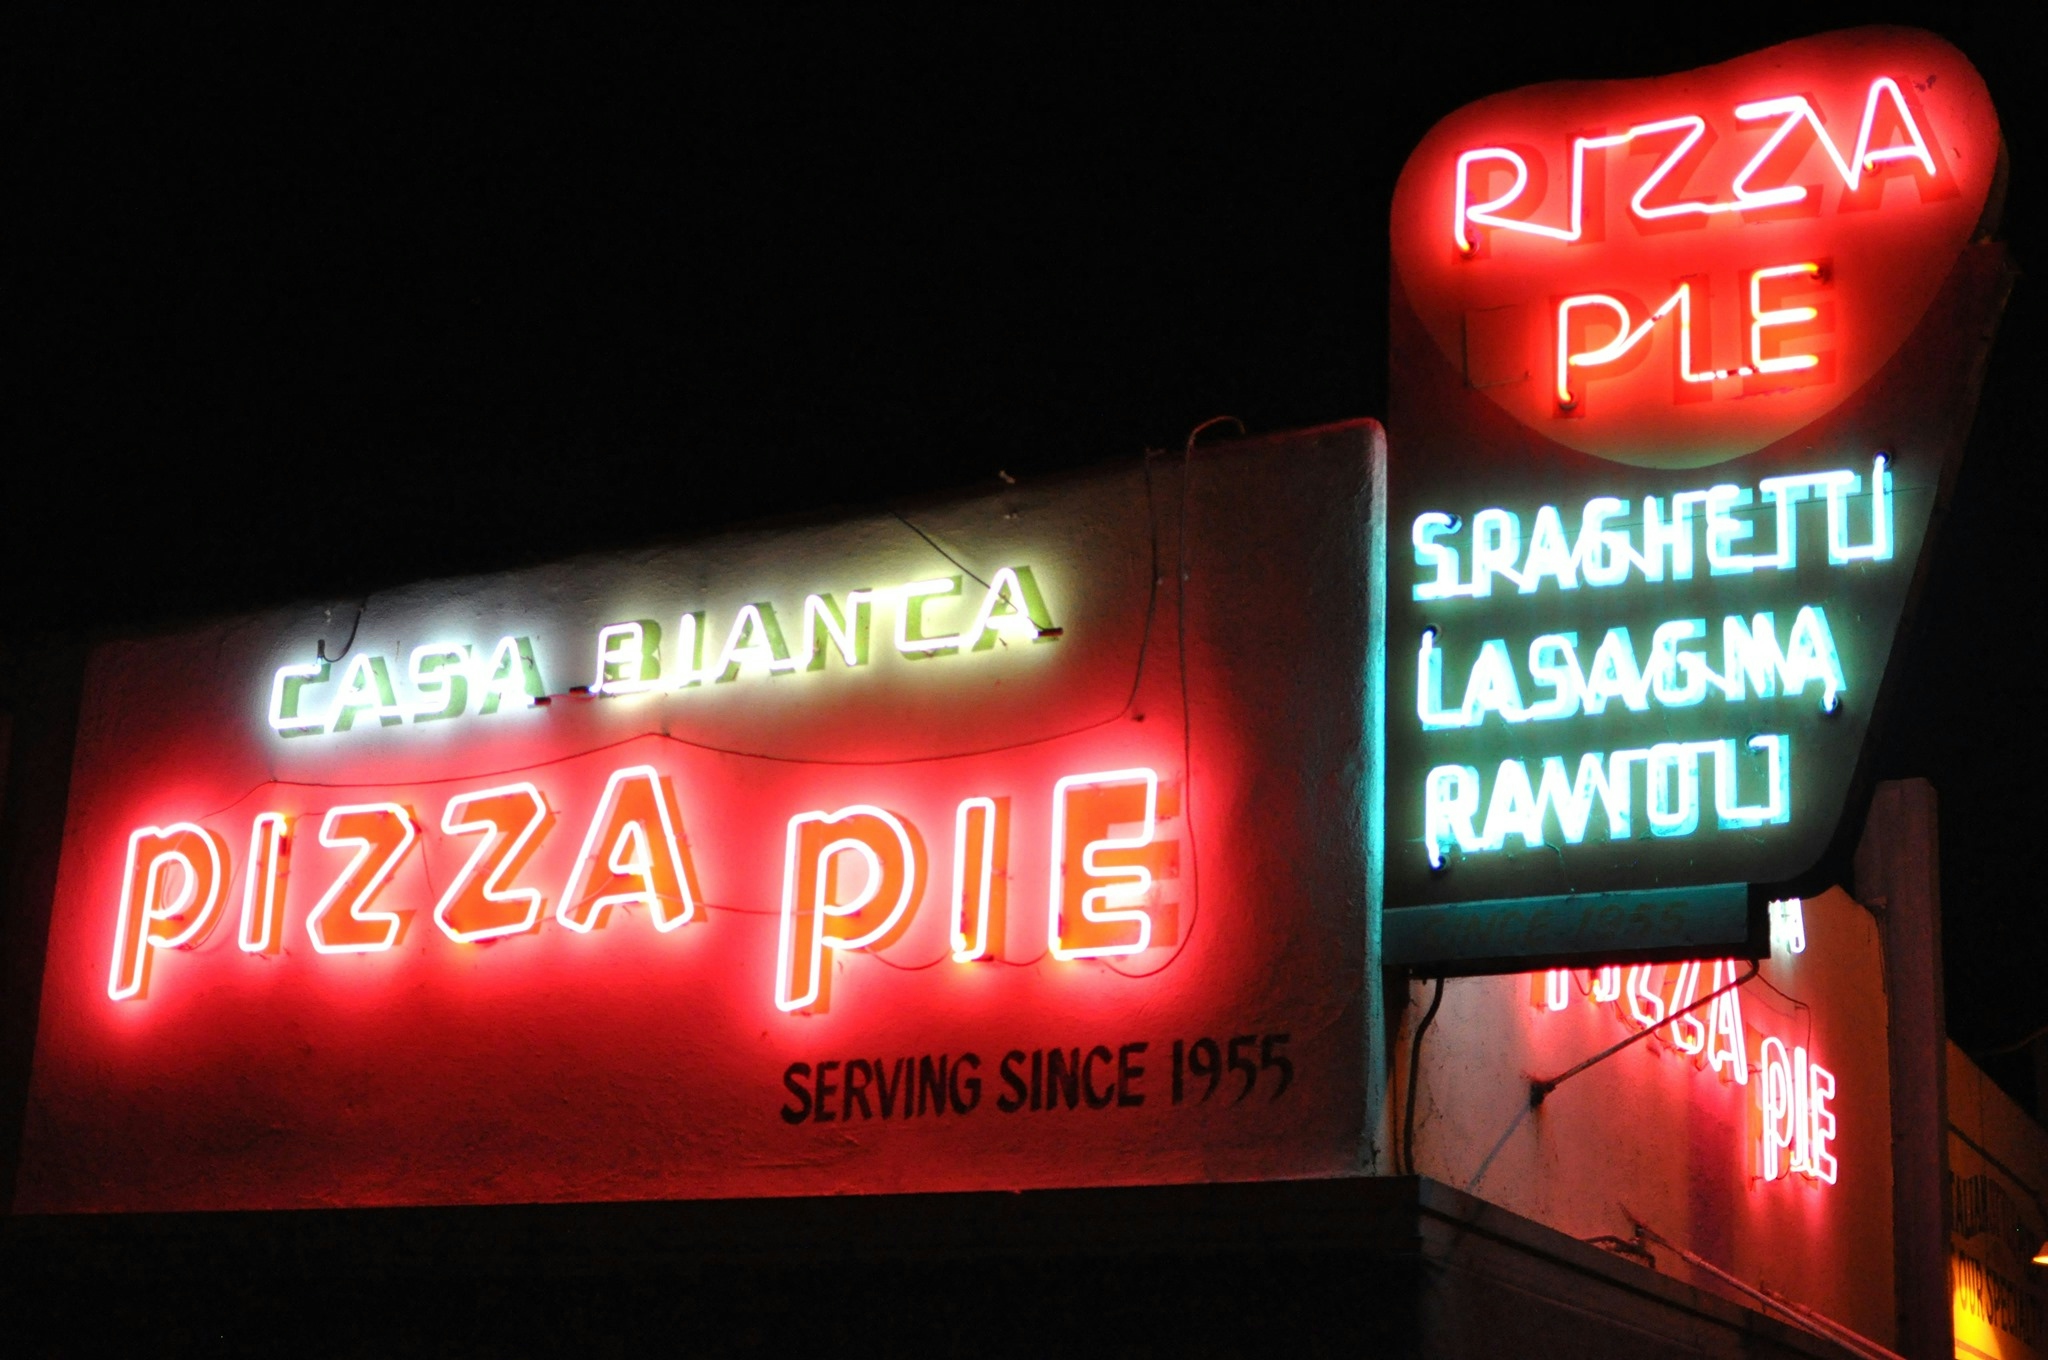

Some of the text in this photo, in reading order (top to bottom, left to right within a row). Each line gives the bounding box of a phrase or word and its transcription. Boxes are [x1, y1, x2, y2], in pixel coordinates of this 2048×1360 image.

[268, 566, 1058, 738] CASA BIANCA
[106, 765, 1180, 1015] PIZZA PIE
[780, 1033, 1295, 1125] SERVING SINCE 1955
[1760, 1036, 1838, 1186] PIE
[1957, 1250, 1986, 1322] OUR
